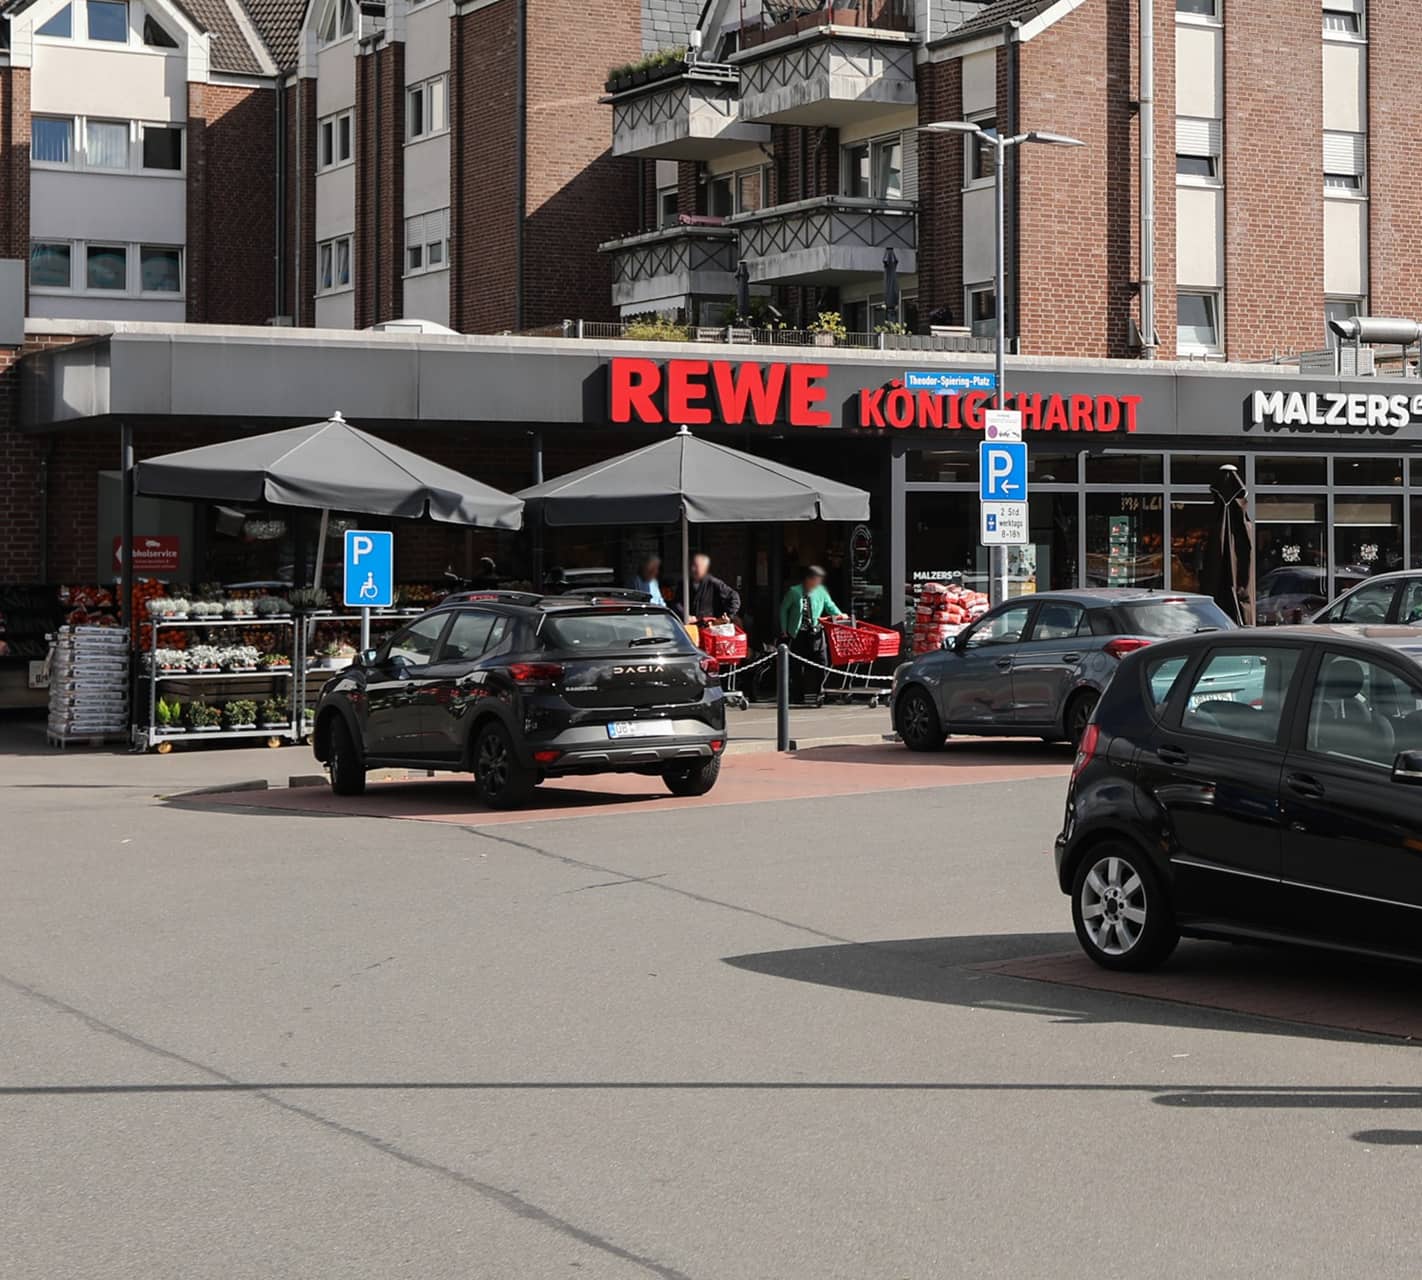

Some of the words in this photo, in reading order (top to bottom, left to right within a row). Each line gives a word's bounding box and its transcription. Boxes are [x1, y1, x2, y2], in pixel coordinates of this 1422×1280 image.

[611, 357, 832, 427] REWE
[909, 374, 991, 388] Theodor-Spiering-Platz
[859, 378, 1143, 433] KÖNIGHARDT
[1254, 390, 1410, 427] MALZERS
[988, 450, 1013, 494] P
[132, 549, 177, 558] bholservice
[353, 536, 373, 565] P
[913, 571, 952, 580] MALZERS
[613, 665, 665, 674] DACIA
